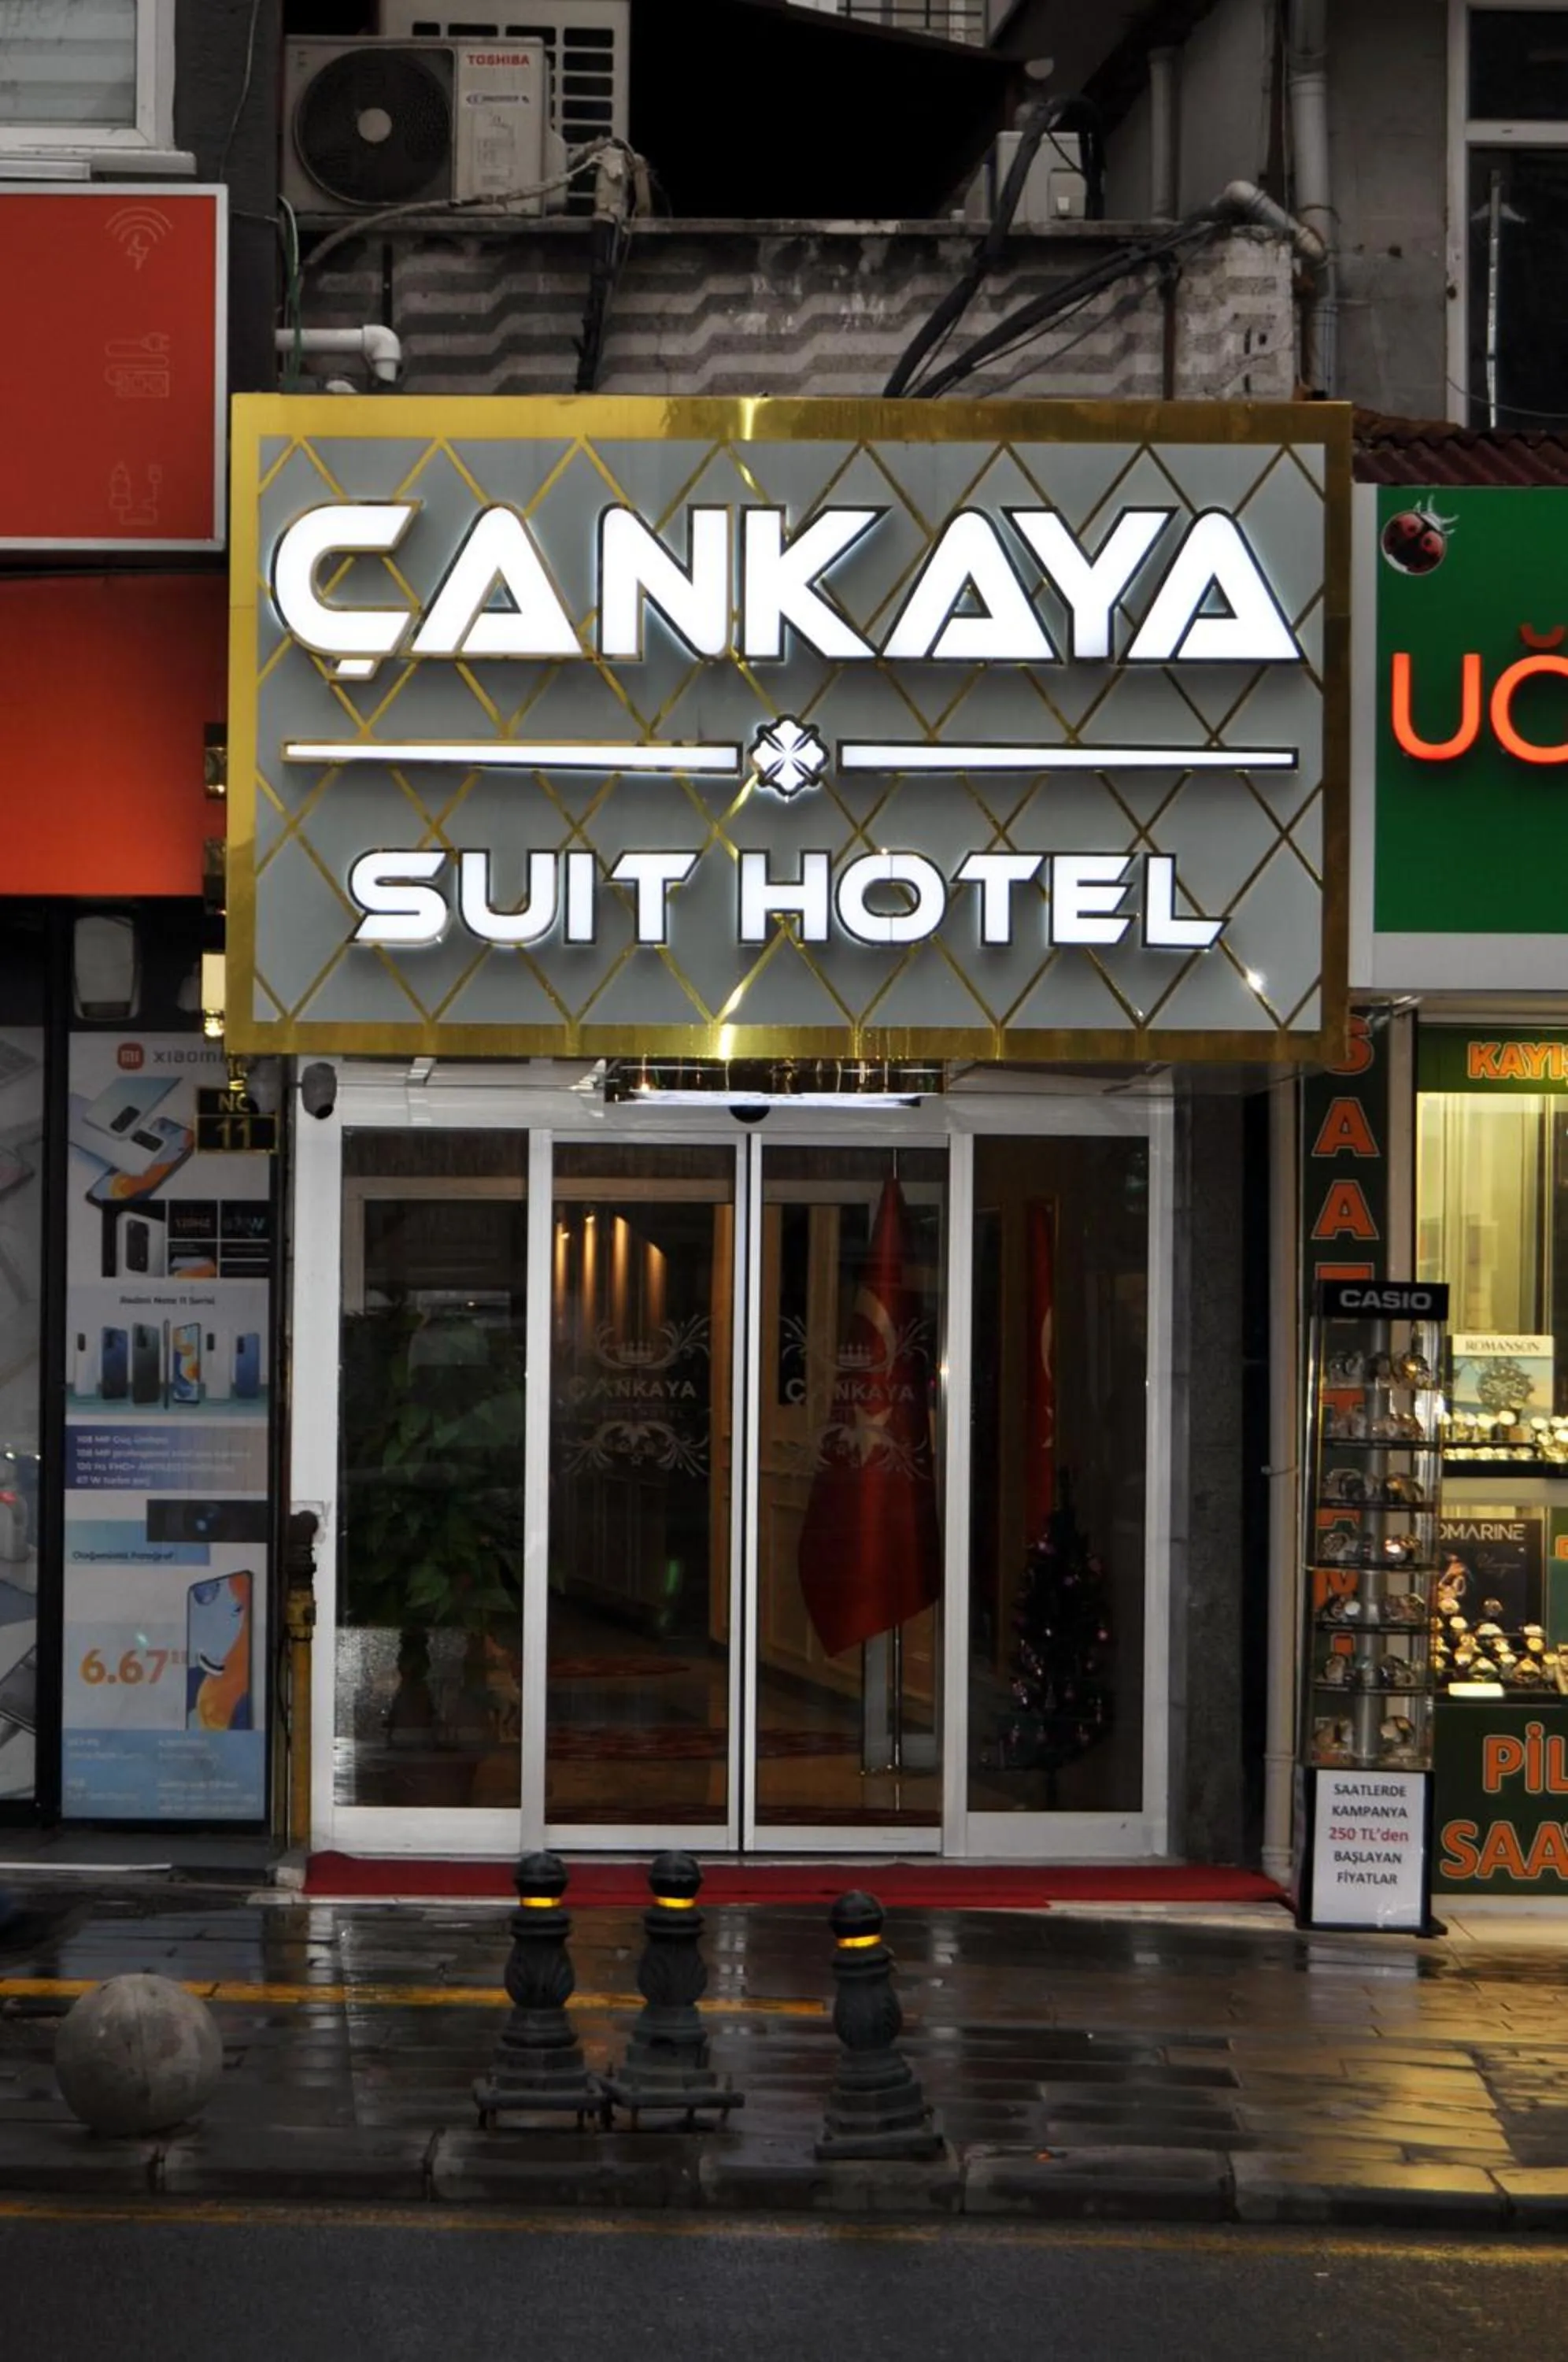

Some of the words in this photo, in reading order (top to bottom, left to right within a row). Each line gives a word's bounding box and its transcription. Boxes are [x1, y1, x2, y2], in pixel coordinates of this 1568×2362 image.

[466, 54, 530, 65] TOSHIBA
[270, 500, 1305, 682] ÇANKAYA
[346, 847, 703, 946] SUIT
[737, 848, 1232, 951] HOTEL
[1467, 1041, 1568, 1084] KAYI
[215, 1116, 251, 1150] 11
[1338, 1289, 1433, 1311] CASIO
[1465, 1340, 1540, 1352] ROMANSON
[785, 1376, 915, 1405] ÇNKAYA
[1483, 1720, 1568, 1794] PİL
[1333, 1783, 1407, 1797] SAATLERDE
[1332, 1805, 1408, 1819] KAMPANYA
[1329, 1827, 1356, 1841] 250
[1361, 1827, 1409, 1842] TL'den
[1333, 1850, 1402, 1865] BAŞLAYAN
[1440, 1819, 1568, 1880] SAA
[1337, 1869, 1397, 1885] FİYATLAR
